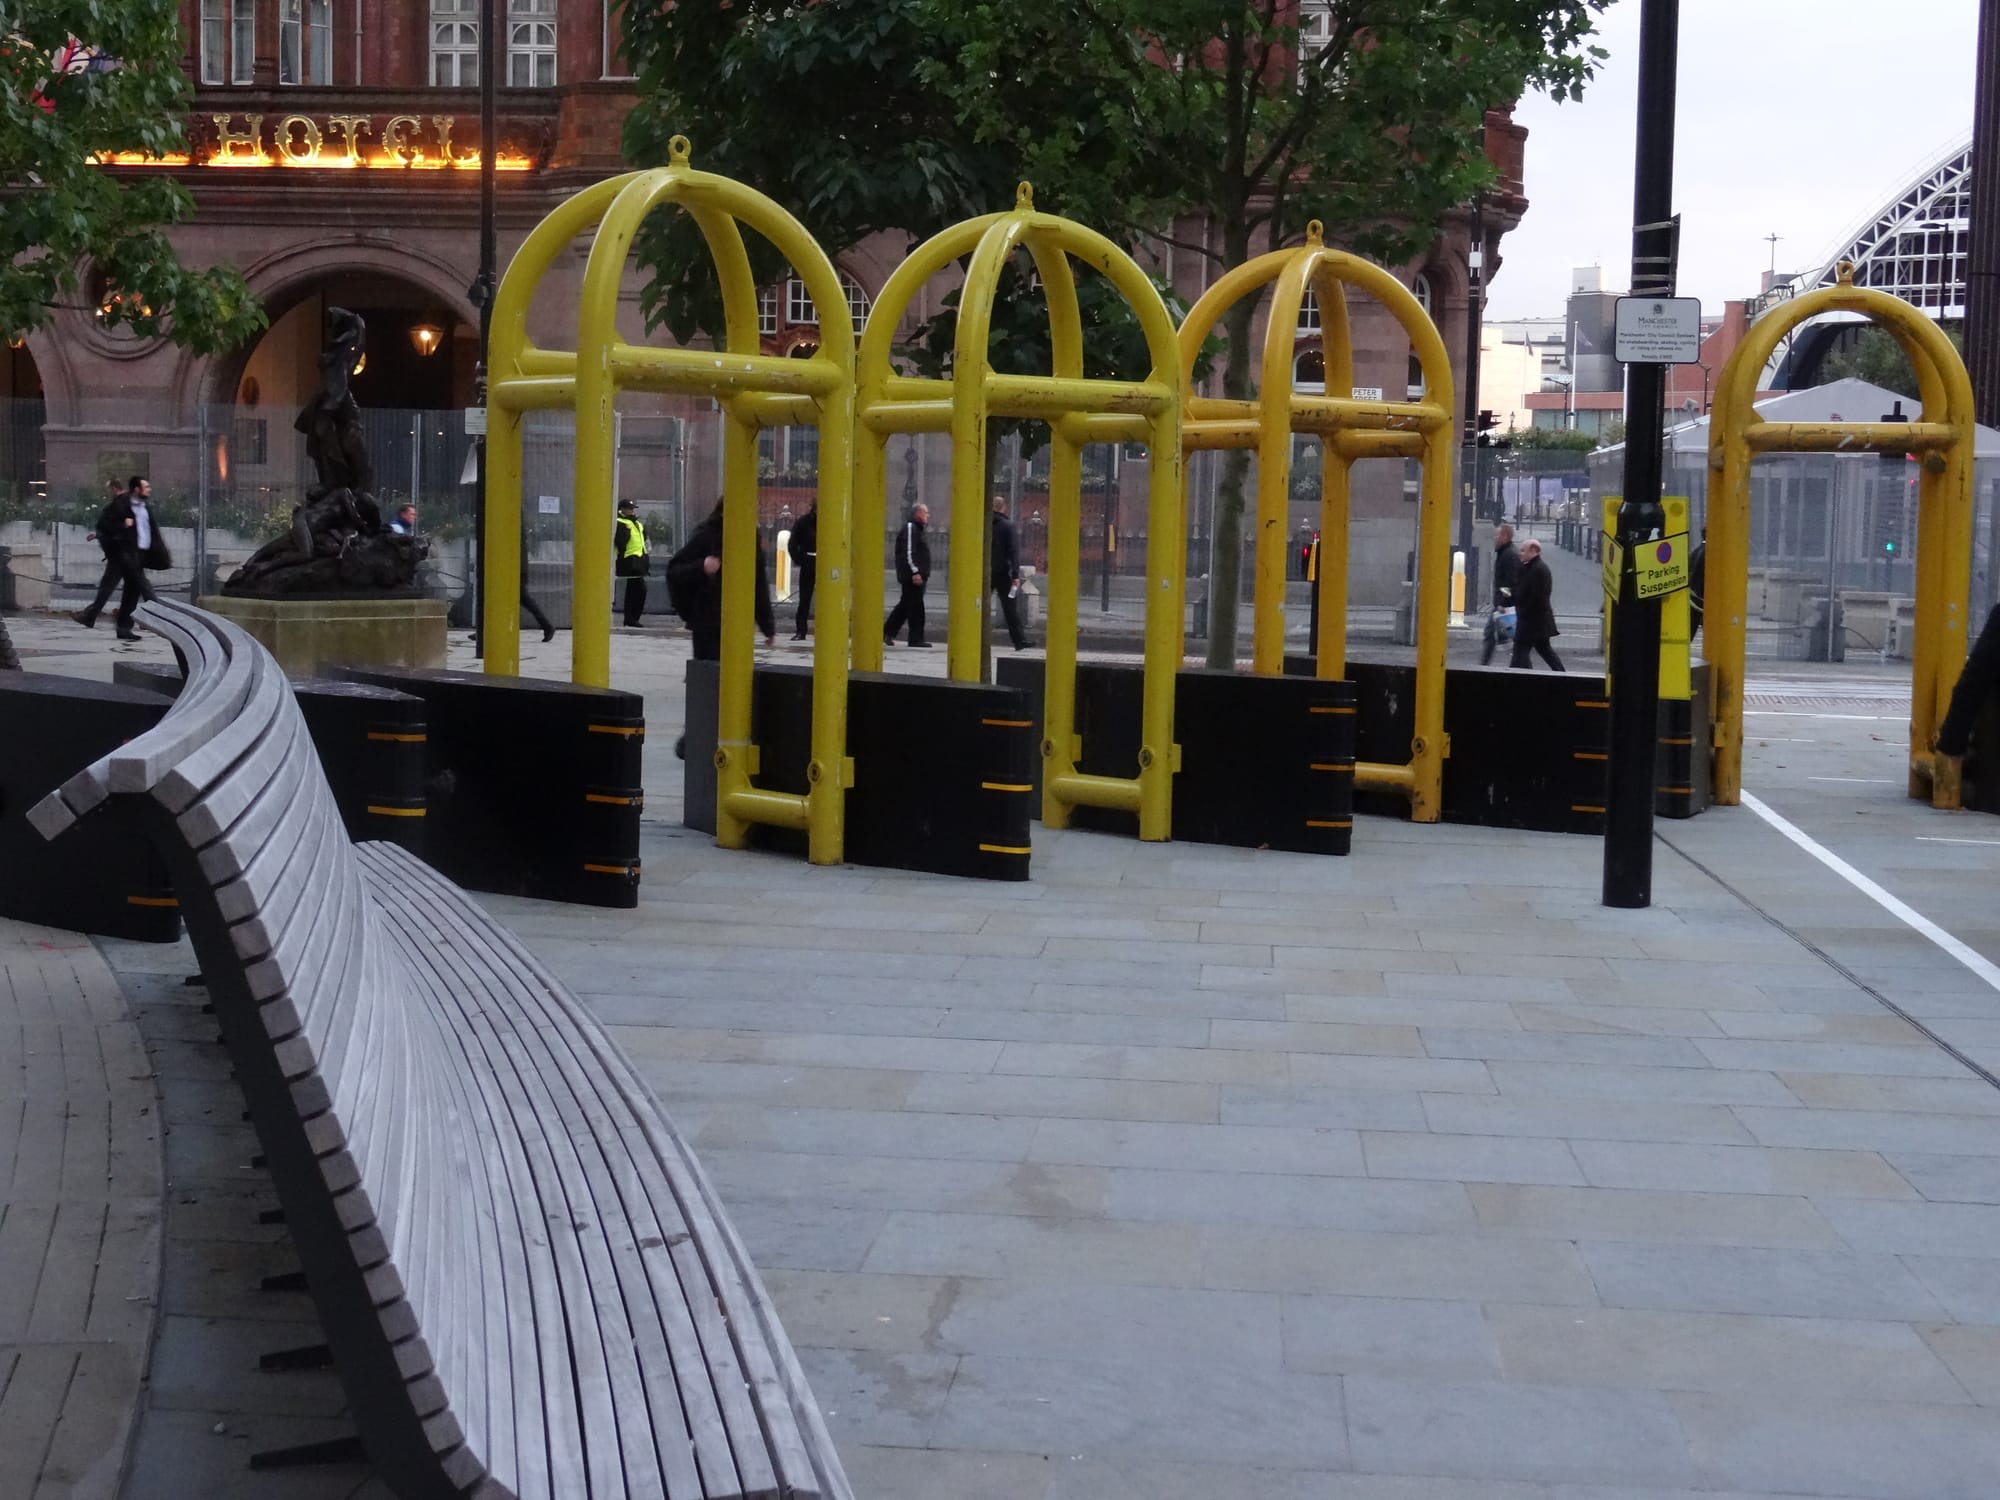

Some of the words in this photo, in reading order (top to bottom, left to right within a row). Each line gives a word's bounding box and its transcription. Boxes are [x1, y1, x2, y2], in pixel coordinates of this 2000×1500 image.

[212, 113, 482, 167] HOTEL
[1648, 564, 1680, 580] Parking
[1640, 576, 1687, 595] Suspension
